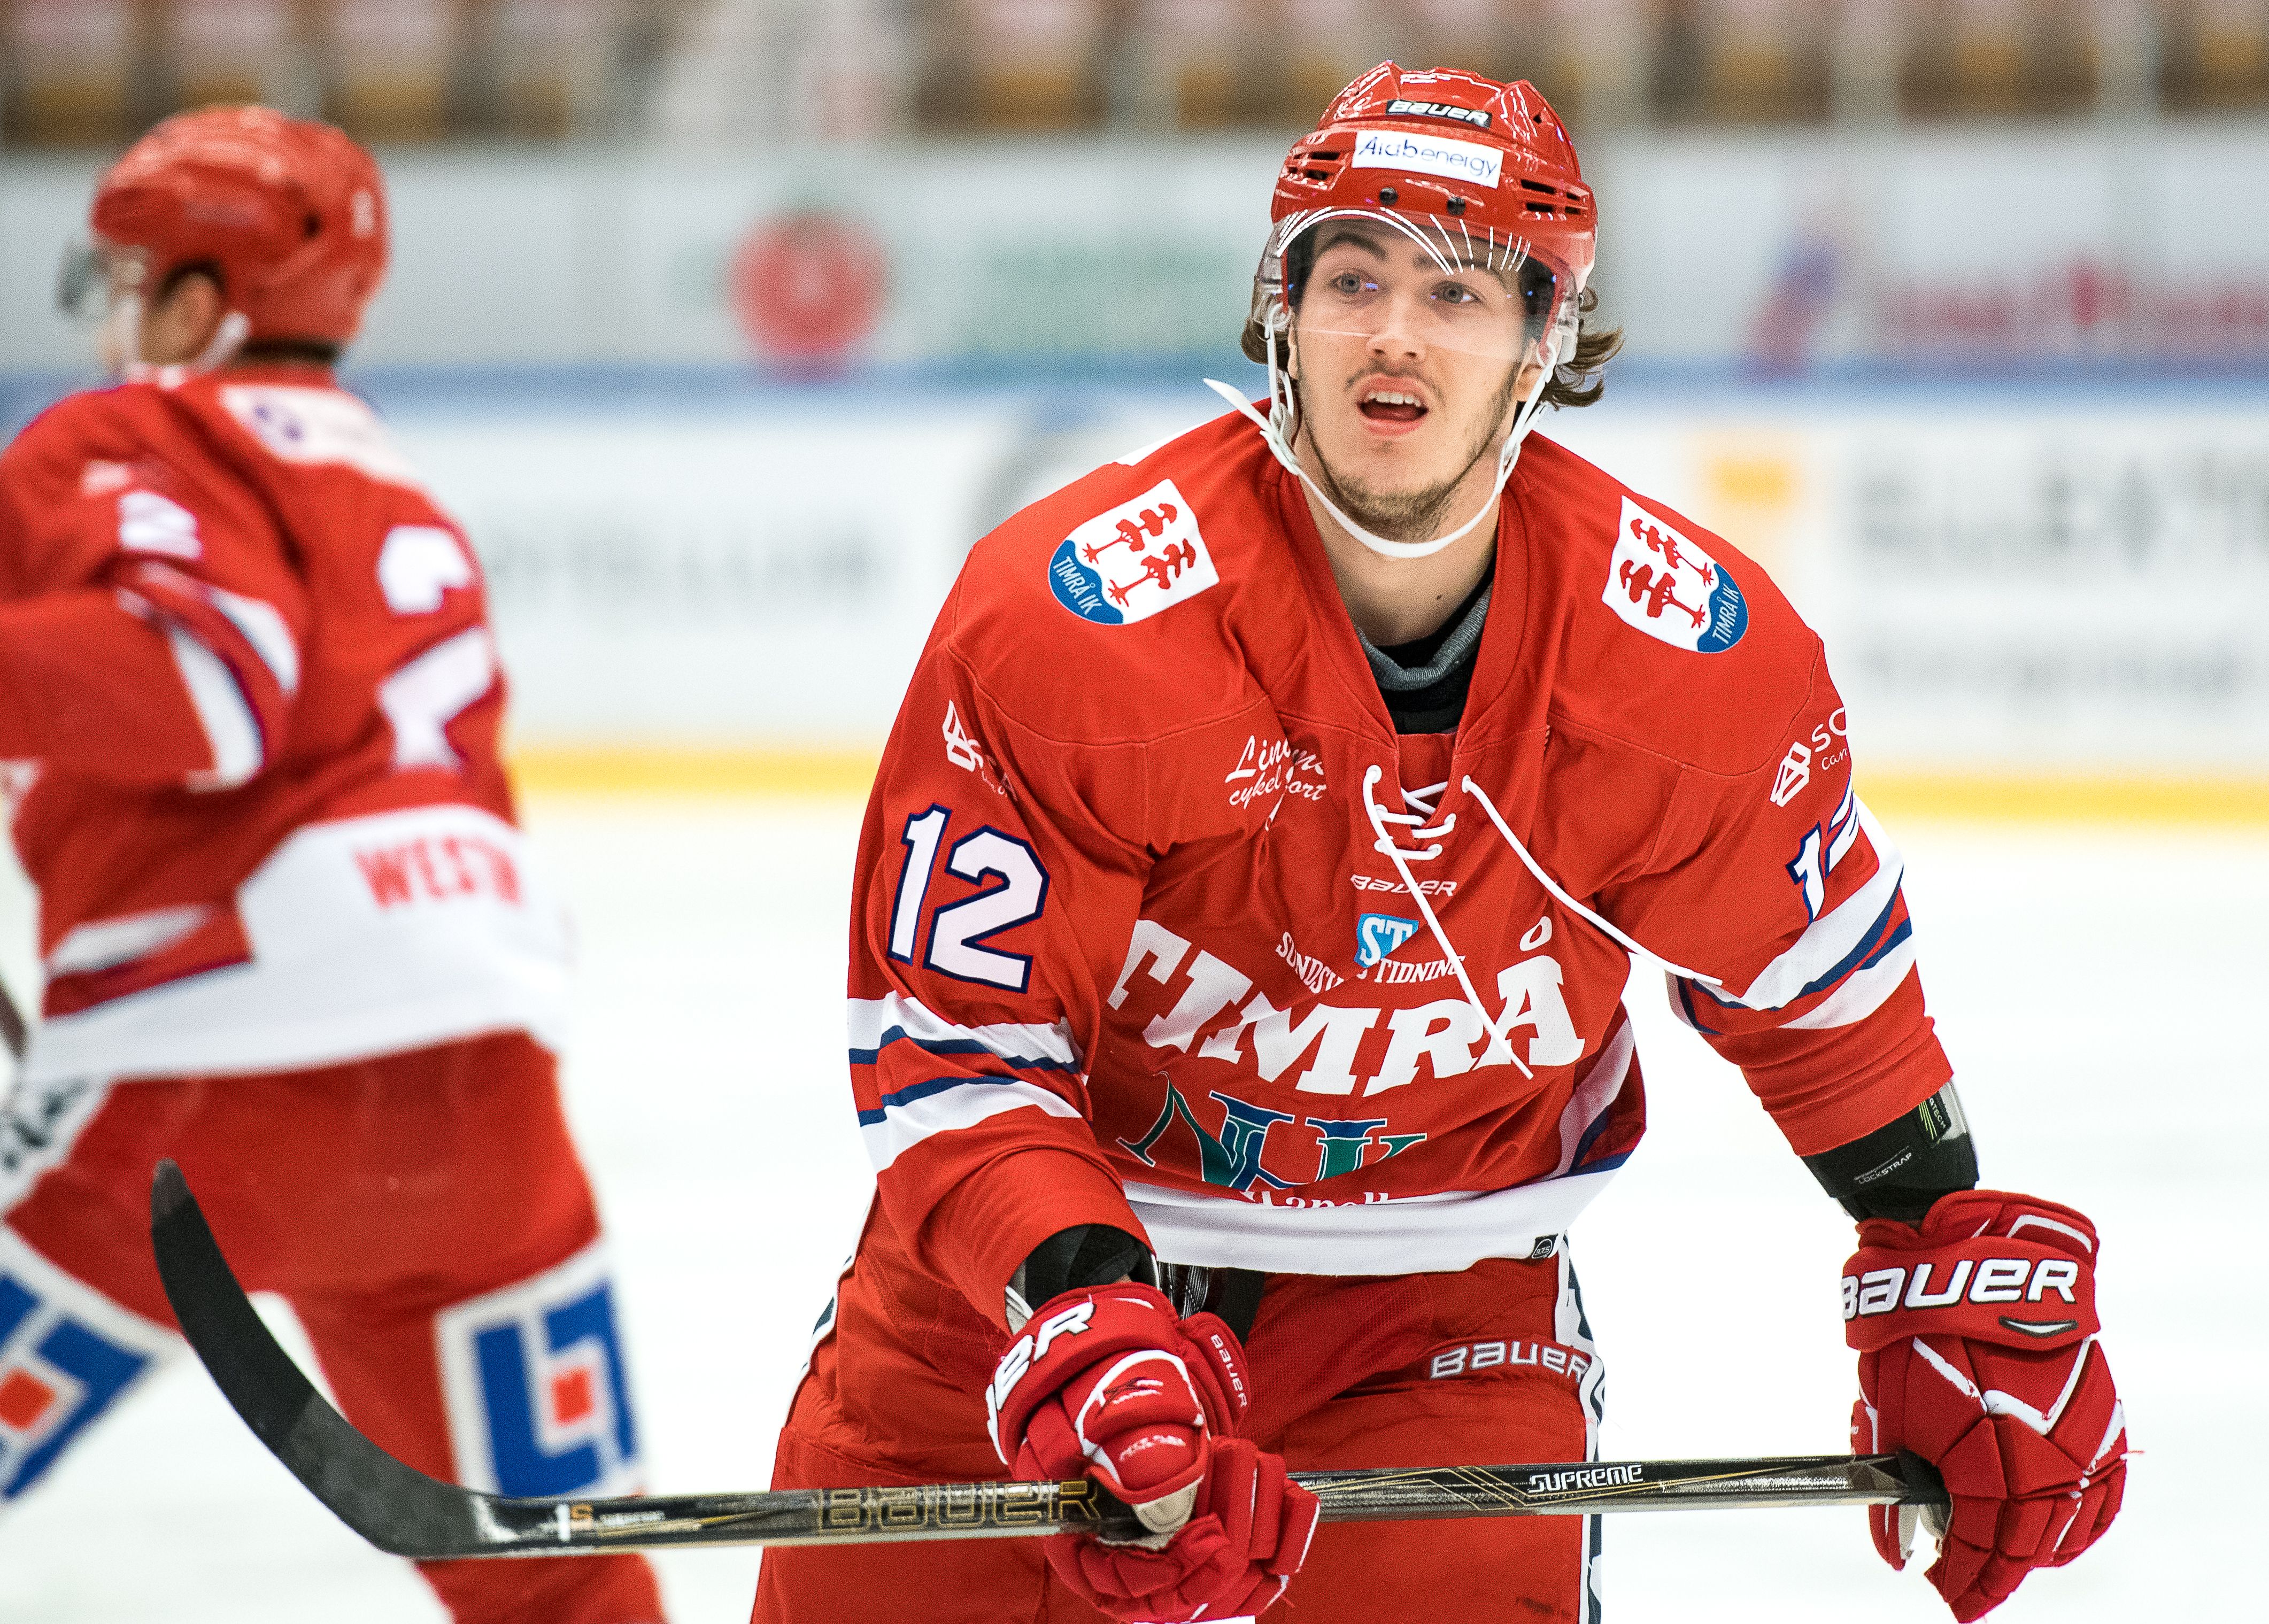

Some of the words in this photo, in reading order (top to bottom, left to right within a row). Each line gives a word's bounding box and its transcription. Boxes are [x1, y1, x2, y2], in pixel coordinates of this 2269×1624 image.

[1388, 100, 1489, 127] BAUER
[1053, 555, 1095, 599] TIMRÅ
[1077, 594, 1102, 615] IK
[1723, 583, 1740, 605] IK
[1712, 596, 1737, 645] TIMRÅ
[886, 801, 1051, 994] 12
[1359, 916, 1413, 966] ST
[1107, 916, 1585, 1097] TIMRÅ
[1841, 1258, 2078, 1321] BAUER
[1210, 1334, 1248, 1408] BAUER
[1429, 1340, 1593, 1385] BAUER
[1527, 1464, 1644, 1494] SUPREME
[819, 1479, 1102, 1534] BAUER
